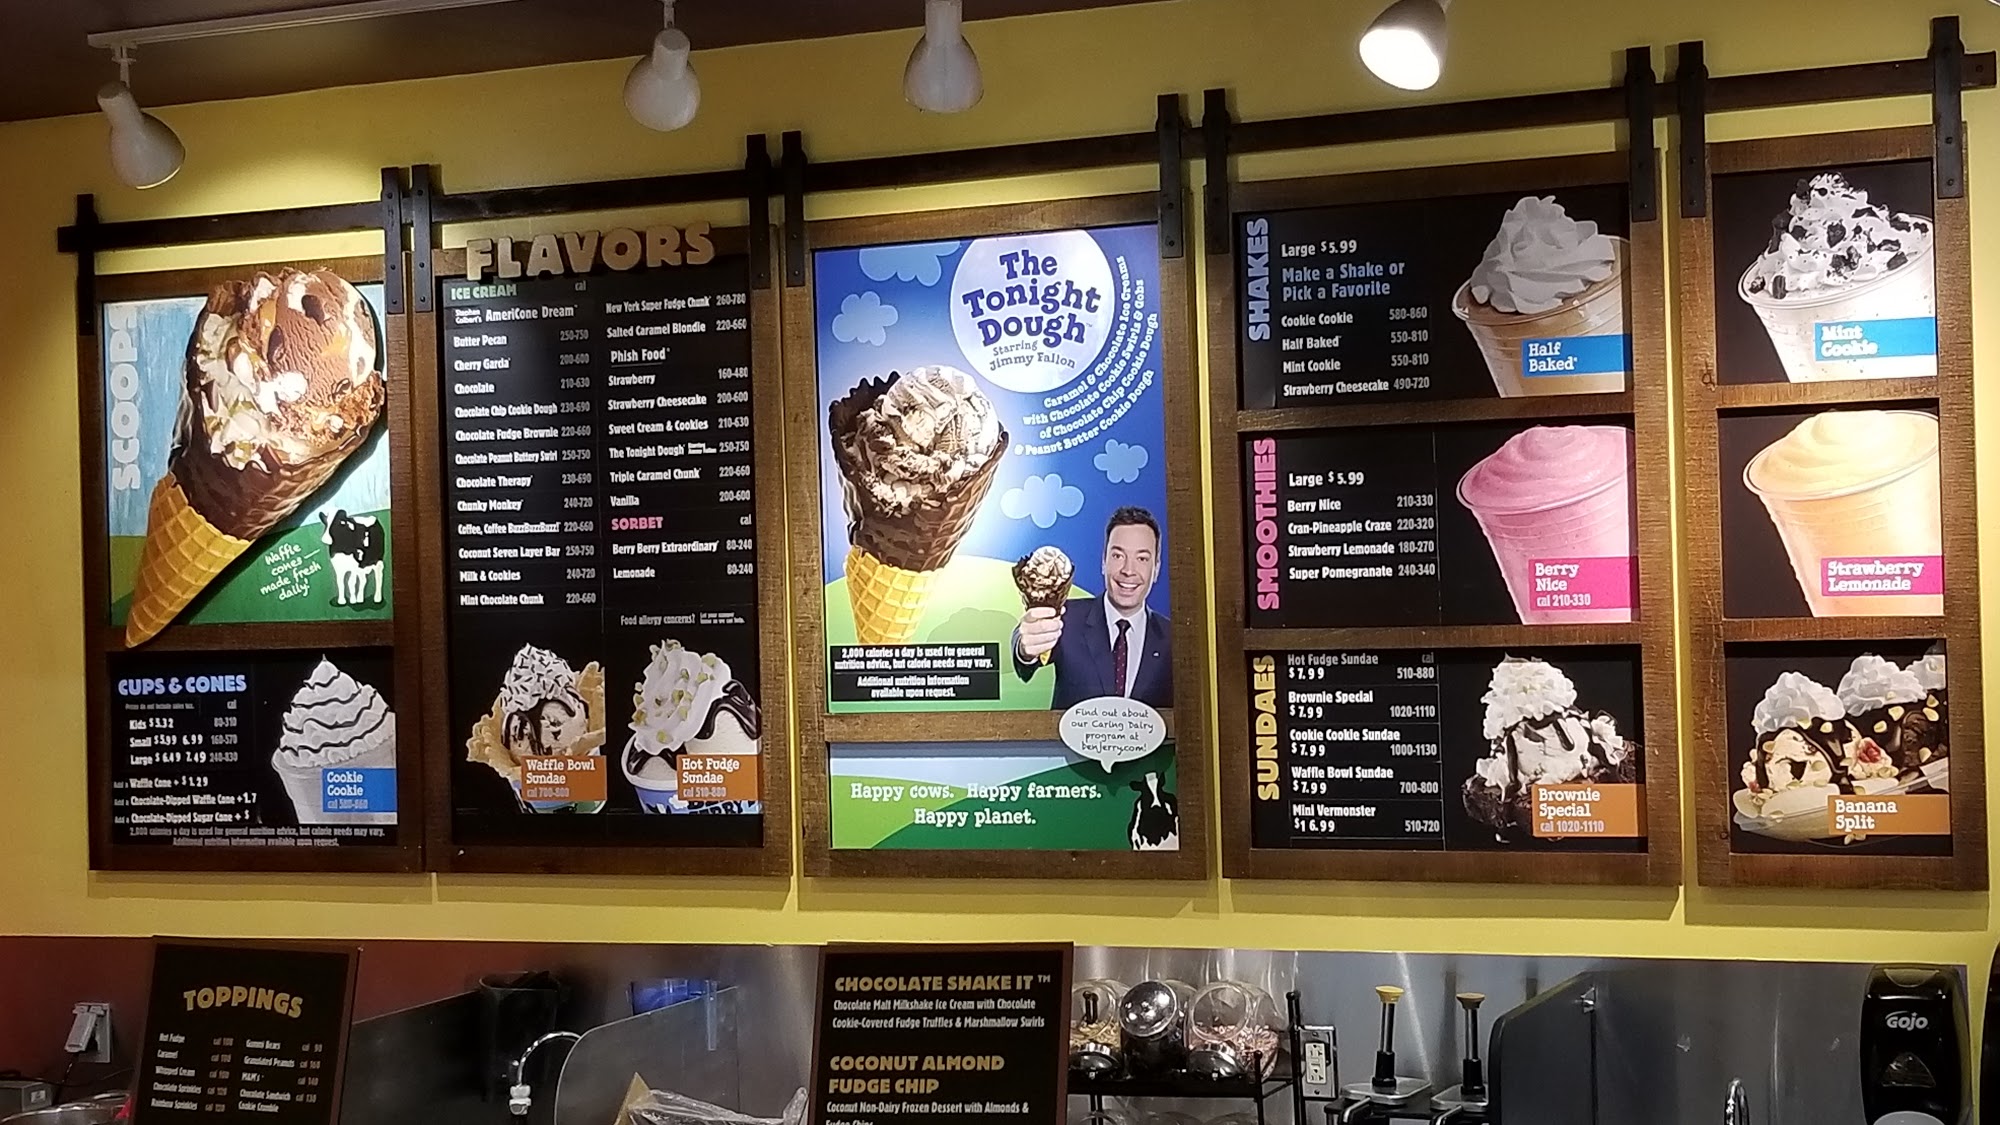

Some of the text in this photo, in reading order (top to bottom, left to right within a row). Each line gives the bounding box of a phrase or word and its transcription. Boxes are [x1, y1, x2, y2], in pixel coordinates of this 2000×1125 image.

[467, 222, 715, 281] FLAVORS
[1281, 243, 1316, 258] Large
[999, 250, 1058, 280] The
[1282, 262, 1405, 283] Make a Shake or
[1246, 217, 1270, 342] SHAKES
[451, 284, 517, 300] ICE CREAM
[962, 278, 1101, 318] Tonight
[1283, 281, 1390, 302] Pick a Favorite
[486, 308, 538, 322] AmeriCone
[1281, 312, 1353, 327] Cookie Cookie
[607, 322, 706, 338] Salted Caramel Blondie
[978, 313, 1086, 348] Dough
[1821, 325, 1863, 340] Mint
[454, 335, 480, 348] Butter
[993, 339, 1038, 357] Starring
[1282, 337, 1304, 351] Half
[1821, 339, 1878, 357] Cookie
[611, 349, 638, 363] Phish
[1528, 342, 1560, 357] Half
[454, 360, 482, 373] Cherry
[989, 352, 1076, 371] Jimmy Fallon
[1283, 358, 1341, 374] Mint Cookie
[1528, 357, 1574, 373] Baked
[608, 374, 656, 387] Strawberry
[455, 382, 495, 395] Chocolate
[1283, 379, 1389, 398] Strawberry Cheesecake
[109, 304, 141, 490] SCOOPS
[608, 394, 707, 411] Strawberry Cheesecake
[609, 418, 709, 435] Sweet Cream Cookies
[610, 469, 671, 483] Triple Caramel
[1289, 472, 1323, 488] Large
[1287, 494, 1433, 514] Berry Nice 210-330
[611, 516, 664, 530] SORBET
[1253, 437, 1280, 610] SMOOTHIES
[1288, 517, 1434, 536] Cran-Pineapple Craze 220-320
[265, 543, 302, 565] Waffle
[613, 541, 660, 556] Berry Berry
[1288, 540, 1434, 558] Strawberry Lemonade 180-270
[271, 556, 303, 576] cones
[289, 562, 322, 583] fresh
[613, 567, 655, 579] Lemonade
[1289, 563, 1435, 581] Super Pomegranate 240-340
[1535, 562, 1579, 578] Berry
[1828, 560, 1924, 577] Strawberry
[279, 579, 311, 601] daily!
[1535, 578, 1567, 593] Nice
[1828, 577, 1911, 592] Lemonade
[1552, 593, 1591, 607] 210-330
[901, 647, 915, 658] day
[1288, 652, 1378, 667] Hot Fudge Sundae
[1397, 666, 1434, 680] 510-880
[118, 674, 247, 696] CUPS & CONES
[1288, 691, 1373, 705] Brownie Special
[1075, 708, 1149, 718] Find out about
[1390, 704, 1435, 718] 1020-1110
[130, 719, 146, 730] Kids
[1071, 720, 1154, 733] our Caring Dairy
[1253, 655, 1280, 800] SUNDAES
[1085, 732, 1126, 742] program
[1290, 728, 1400, 742] Cookie Cookie Sundae
[1390, 743, 1437, 756] 1000-1130
[527, 759, 595, 771] Waffle Bowl
[682, 758, 740, 771] Hot Fudge
[327, 772, 363, 784] Cookie
[527, 772, 566, 784] Sundae
[682, 772, 723, 784] Sundae
[1291, 766, 1393, 780] Waffle Bowl Sundae
[327, 784, 364, 797] Cookie
[850, 782, 1102, 802] Happy cows. Happy farmers.
[1400, 781, 1438, 794] 700-800
[1538, 788, 1600, 802] Brownie
[1293, 804, 1375, 818] Mini Vermonster
[1539, 803, 1591, 818] Special
[1835, 799, 1898, 813] Banana
[914, 808, 1037, 827] Happy planet.
[1836, 815, 1875, 832] Split
[1405, 819, 1440, 833] 510-720
[1556, 820, 1604, 833] 1020-1110
[835, 975, 1033, 991] CHOCOLATE SHAKE IT
[183, 986, 303, 1019] TOPPINGS
[834, 999, 1035, 1011] Chocolate Malt Milkshake Cream with Chocolate
[895, 1016, 1045, 1029] Fudge Marshmallow Swirls
[830, 1055, 1004, 1071] COCONUT ALMOND
[829, 1079, 939, 1094] FUDGE CHIP
[827, 1101, 1019, 1114] Coconut Non-Dairy Frozen Dessert with Almonds
